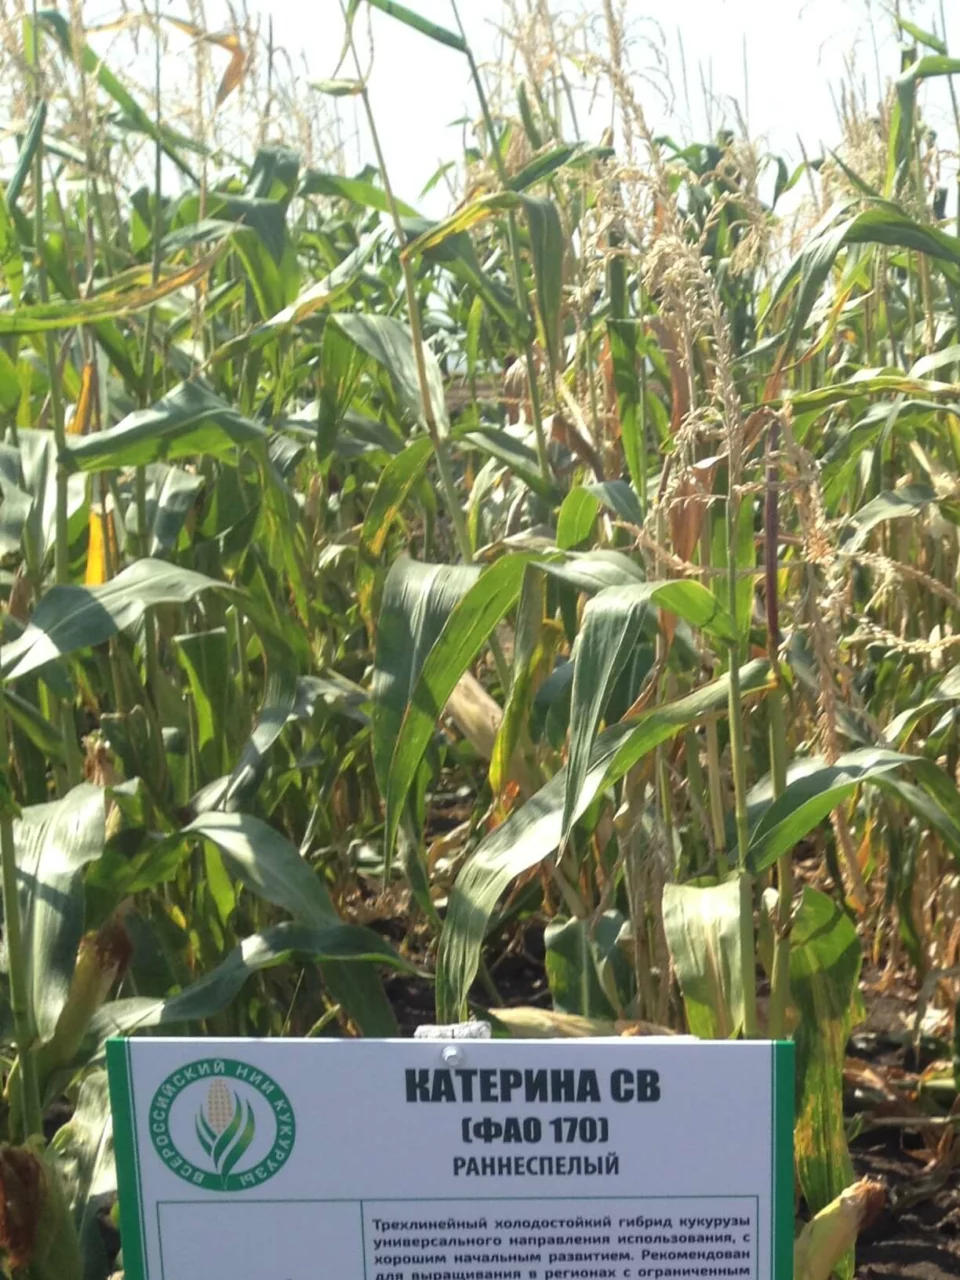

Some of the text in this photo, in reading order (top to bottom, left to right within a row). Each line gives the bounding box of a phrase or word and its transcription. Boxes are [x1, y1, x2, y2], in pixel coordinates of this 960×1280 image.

[404, 1068, 661, 1103] КАТЕРИНА СВ
[152, 1060, 293, 1187] ВСЕРОССИЙСКИЙ НИИ КУКУРУЗЫ
[461, 1116, 609, 1144] (ФАО 170)
[452, 1152, 620, 1177] РАННЕСПЕЛЫЙ
[371, 1216, 750, 1232] Трехлинейный холодостойкий гибрид кукурузы
[373, 1233, 751, 1251] универсального направления использования, с
[374, 1249, 750, 1267] хорошим начальным развитием. Рекомендован
[529, 1270, 537, 1279] в
[623, 1268, 631, 1278] с
[638, 1267, 750, 1280] ограниченным
